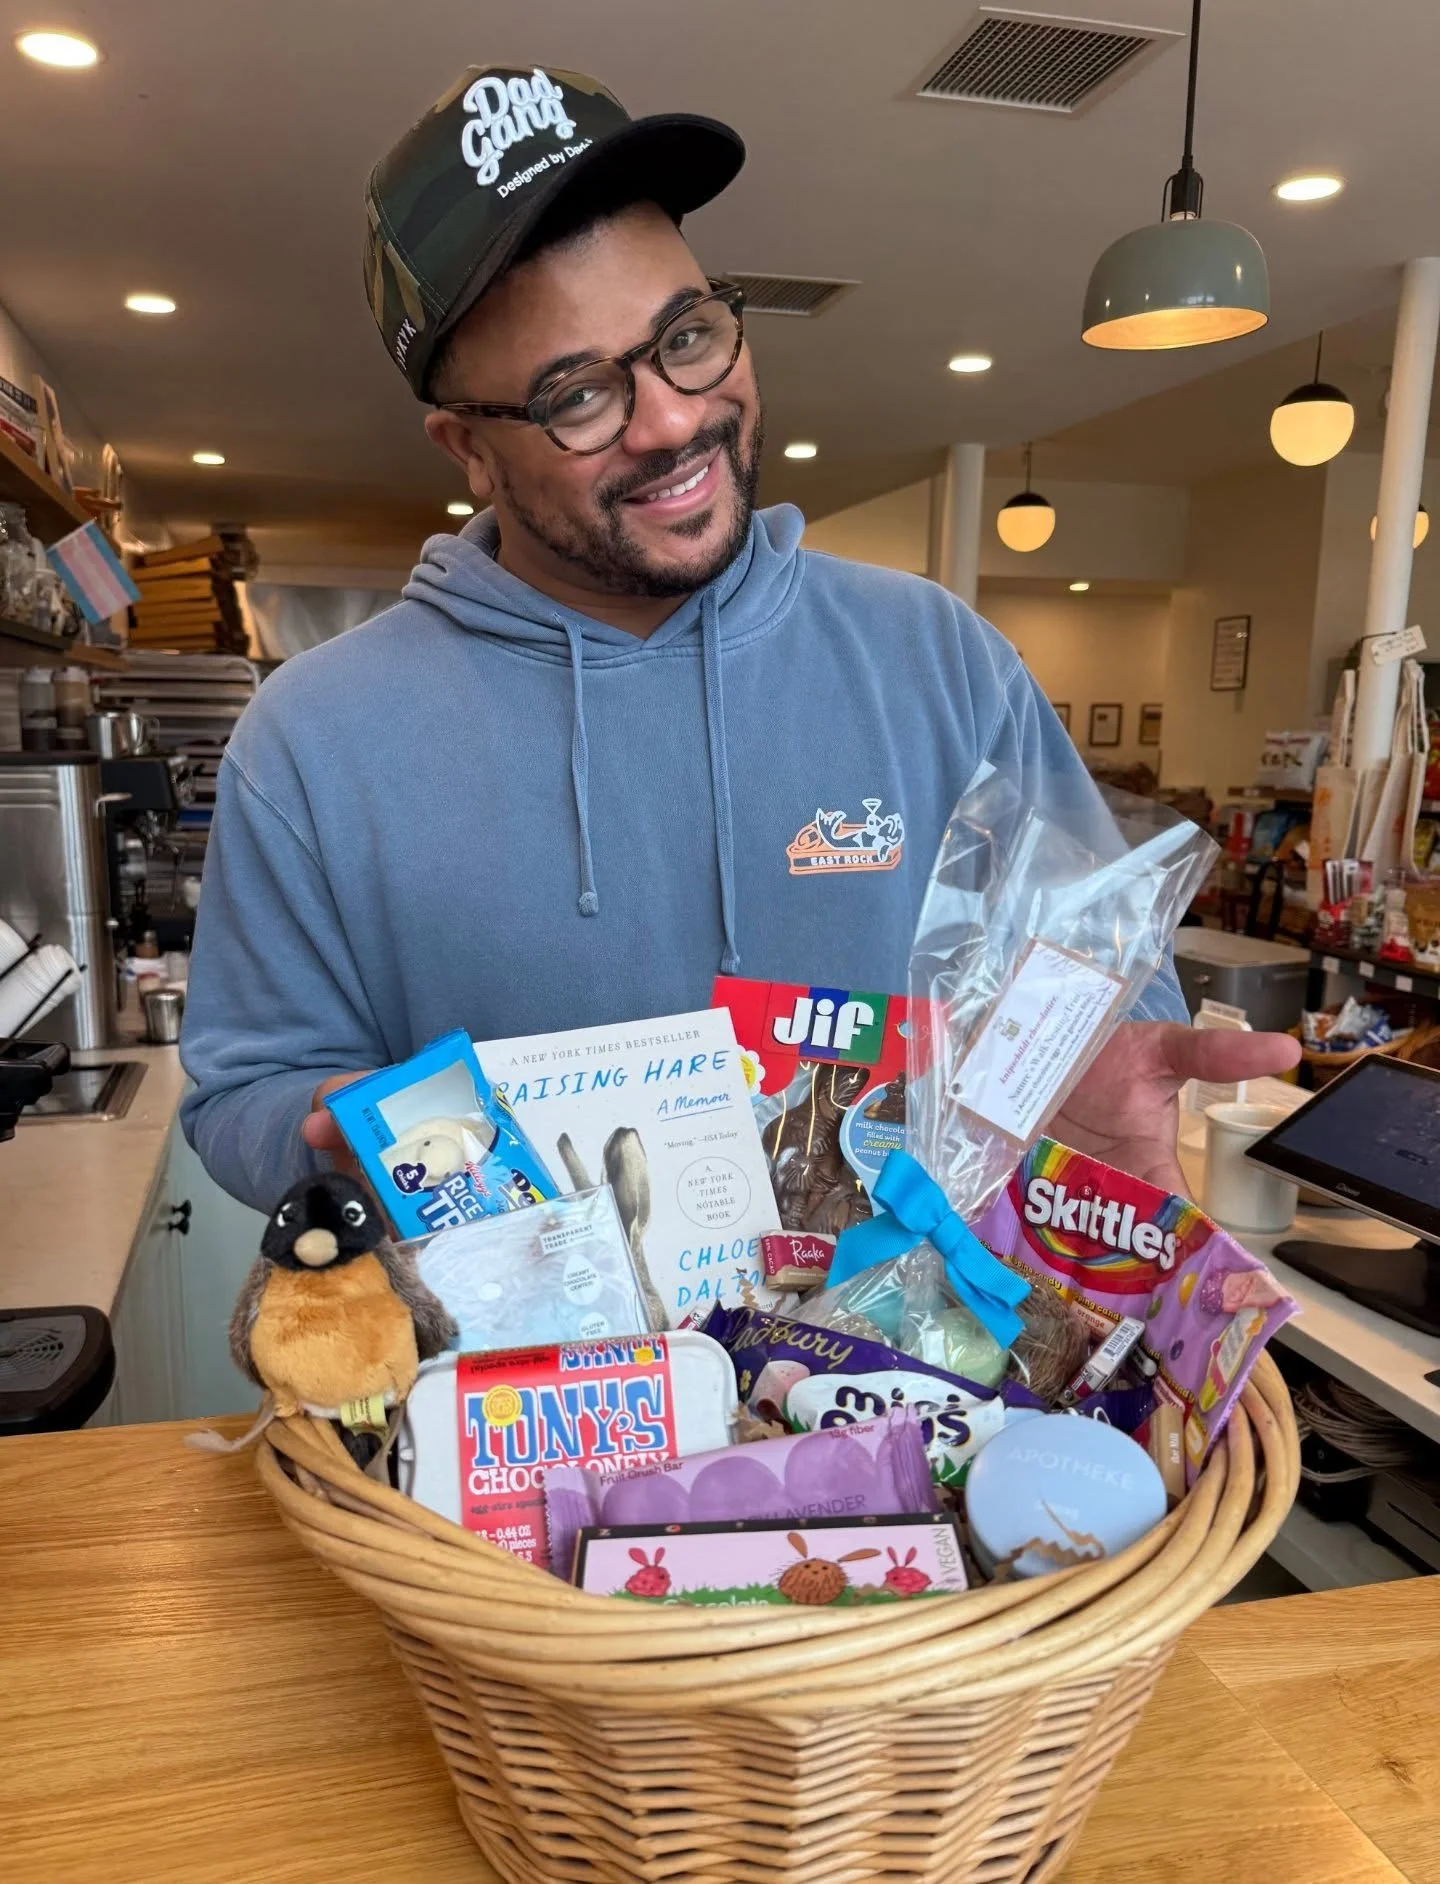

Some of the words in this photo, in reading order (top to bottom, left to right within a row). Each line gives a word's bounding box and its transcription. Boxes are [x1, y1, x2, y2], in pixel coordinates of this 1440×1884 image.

[463, 68, 563, 128] Dad
[462, 100, 577, 186] Gang
[497, 157, 550, 198] Designed
[548, 152, 565, 163] by
[810, 856, 841, 866] EAST
[844, 855, 874, 864] ROCK
[773, 996, 874, 1050] Jif
[510, 1057, 519, 1066] A
[523, 1053, 547, 1065] NEW
[552, 1049, 581, 1061] YORK
[586, 1043, 621, 1056] TIMES
[625, 1030, 701, 1049] BESTSELLER
[644, 1050, 730, 1084] HARE
[657, 1099, 668, 1115] A
[674, 1092, 732, 1112] Memoir
[719, 1131, 738, 1141] Today
[855, 1122, 873, 1130] milk
[863, 1139, 903, 1150] creamy
[867, 1131, 883, 1140] filled
[884, 1134, 900, 1142] with
[854, 1147, 881, 1156] peanut
[396, 1169, 410, 1190] Chicks
[406, 1169, 419, 1180] 5
[688, 1177, 707, 1188] NEW
[711, 1172, 734, 1183] YORK
[444, 1175, 484, 1220] RICE
[700, 1185, 727, 1197] TIMES
[696, 1197, 736, 1210] NOTABLE
[706, 1210, 731, 1221] BOOK
[1024, 1178, 1177, 1271] Skittles
[543, 1224, 593, 1244] TRANSPARENT
[544, 1239, 568, 1250] TRADE
[679, 1237, 761, 1271] CHLOE
[789, 1239, 826, 1266] Raaka
[767, 1253, 776, 1275] CACAO
[563, 1273, 597, 1287] CHOCOLATE
[677, 1269, 767, 1308] DALTO
[1077, 1308, 1105, 1329] orange
[1096, 1304, 1122, 1322] cand
[581, 1321, 605, 1333] GLUTEN
[586, 1327, 602, 1337] FREE
[465, 1373, 669, 1470] TONY'S
[850, 1424, 875, 1435] fiber
[600, 1473, 626, 1486] Fruit
[663, 1462, 684, 1472] Bar
[1007, 1446, 1136, 1491] APOTHEKE
[508, 1538, 537, 1552] pieces
[931, 1527, 957, 1576] VEGAN
